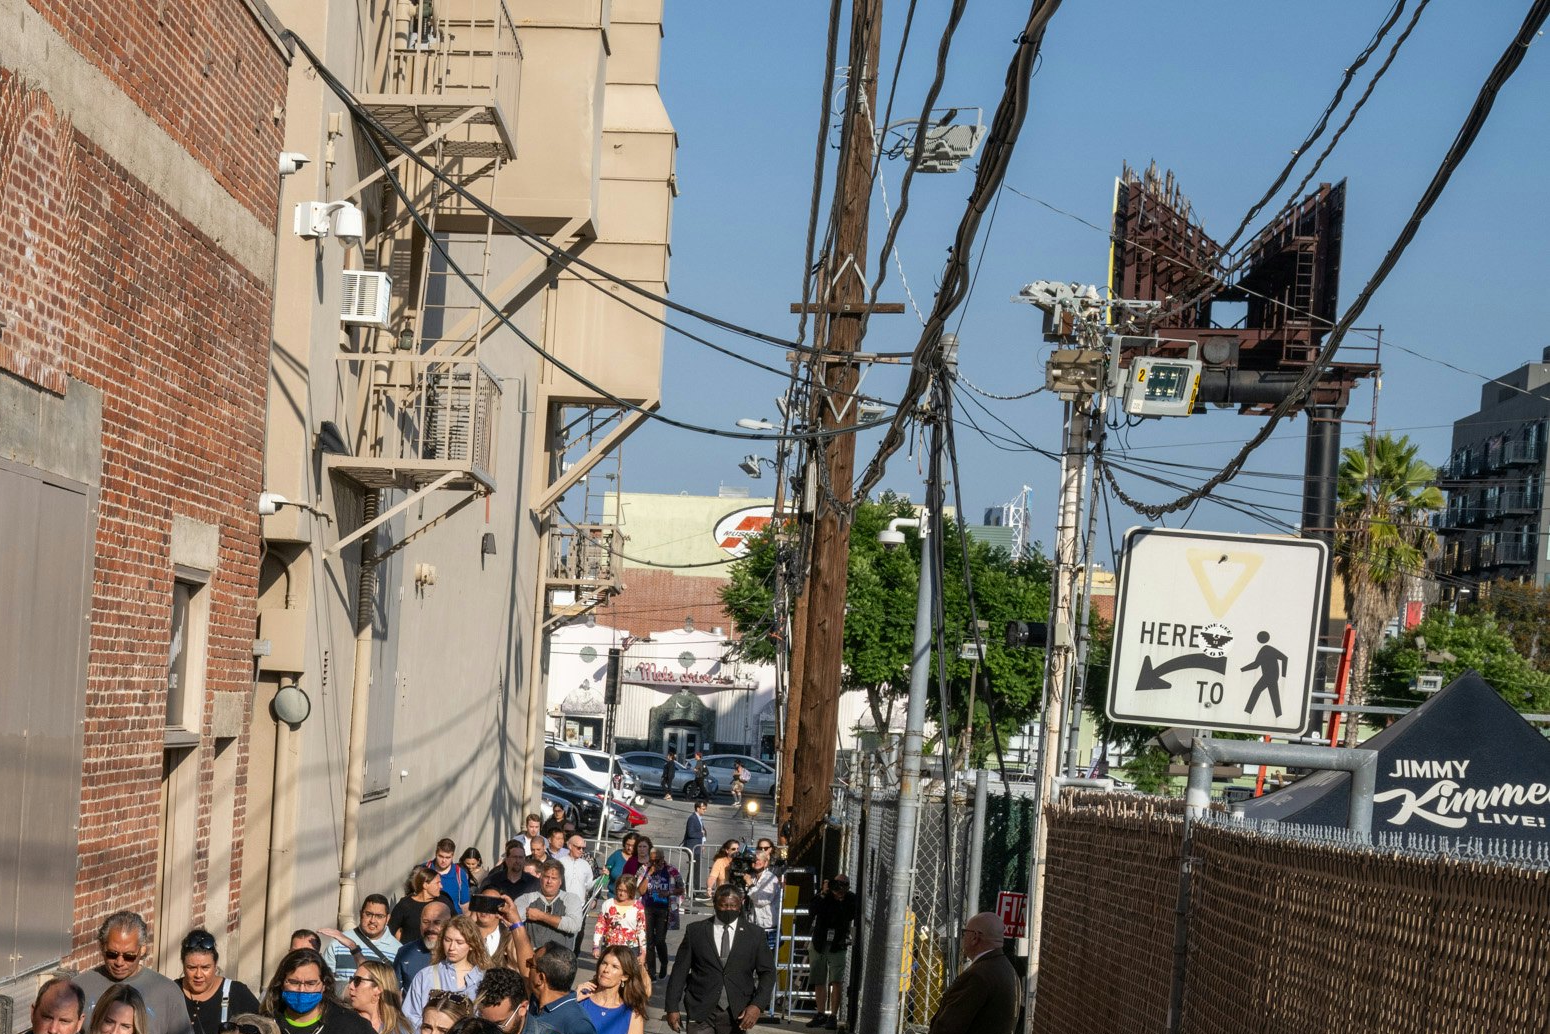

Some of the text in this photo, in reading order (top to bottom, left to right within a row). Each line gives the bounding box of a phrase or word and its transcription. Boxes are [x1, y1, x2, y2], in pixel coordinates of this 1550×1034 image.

[1138, 369, 1146, 383] 2
[1140, 621, 1203, 648] HERE
[1196, 681, 1224, 705] TO
[1388, 759, 1470, 779] JIMMY
[1373, 780, 1550, 829] Kimme
[1477, 812, 1546, 828] LIVE!
[1000, 896, 1028, 923] FIR
